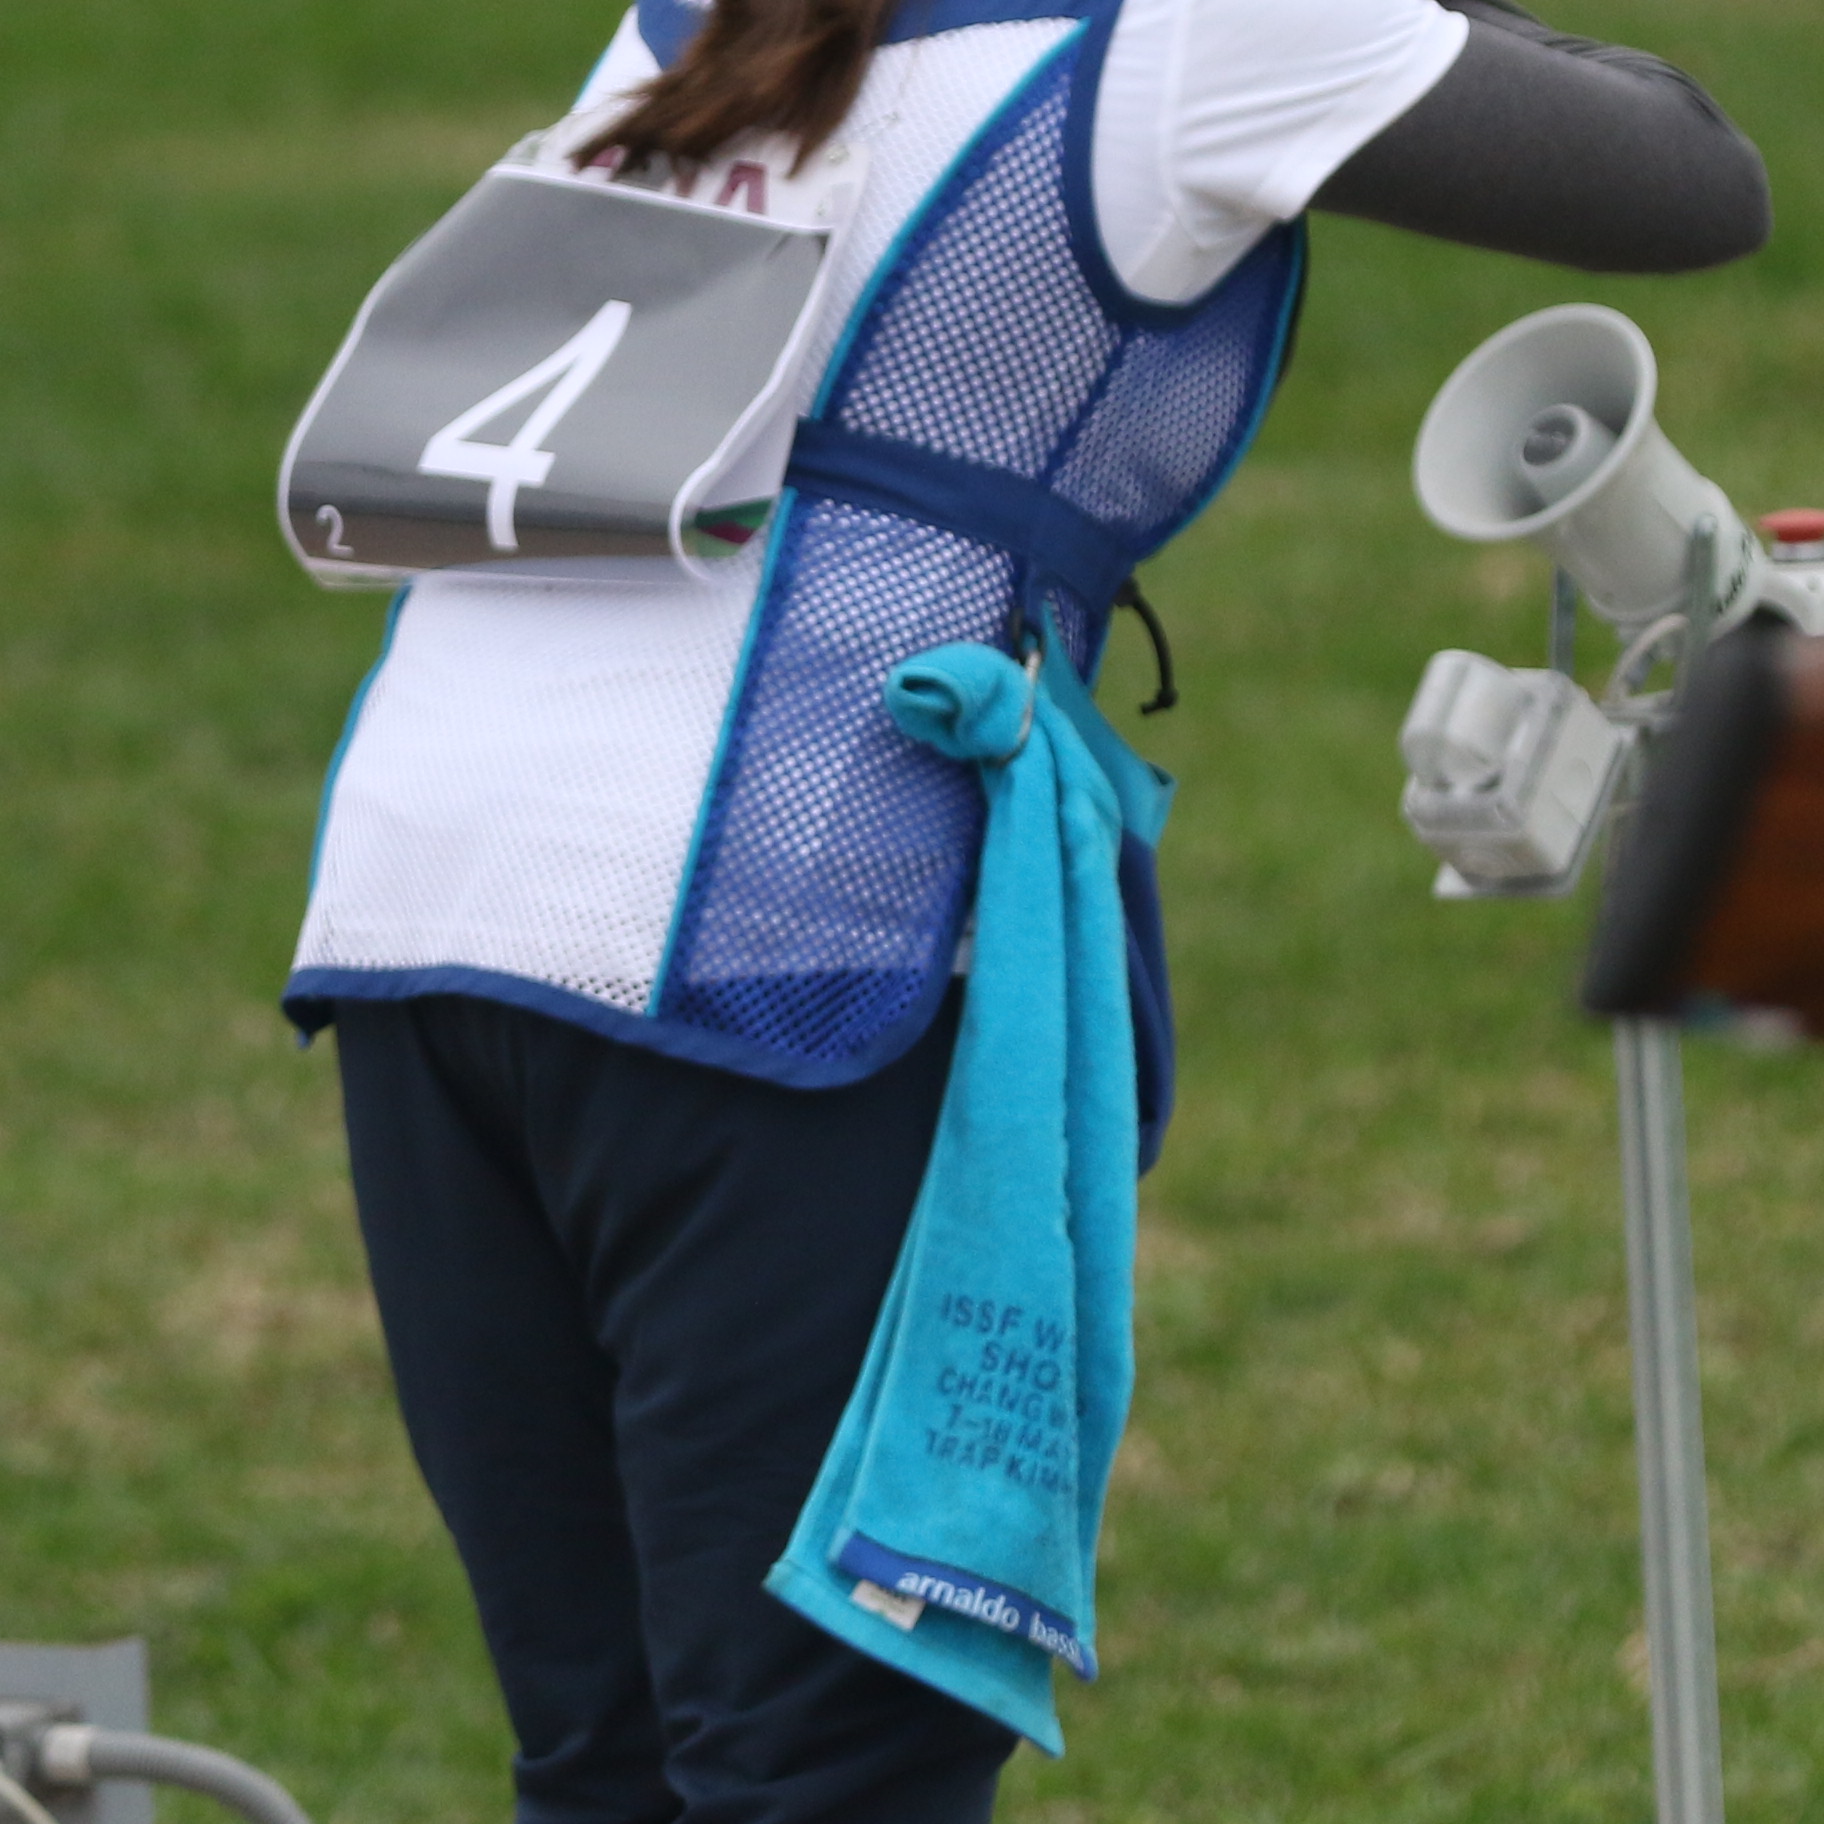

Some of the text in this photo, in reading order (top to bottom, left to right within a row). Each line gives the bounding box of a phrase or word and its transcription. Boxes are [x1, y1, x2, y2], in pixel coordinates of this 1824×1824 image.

[417, 298, 633, 553] 4
[315, 504, 355, 558] 2
[939, 1292, 1024, 1337] ISSF
[895, 1571, 1021, 1632] arnaldo
